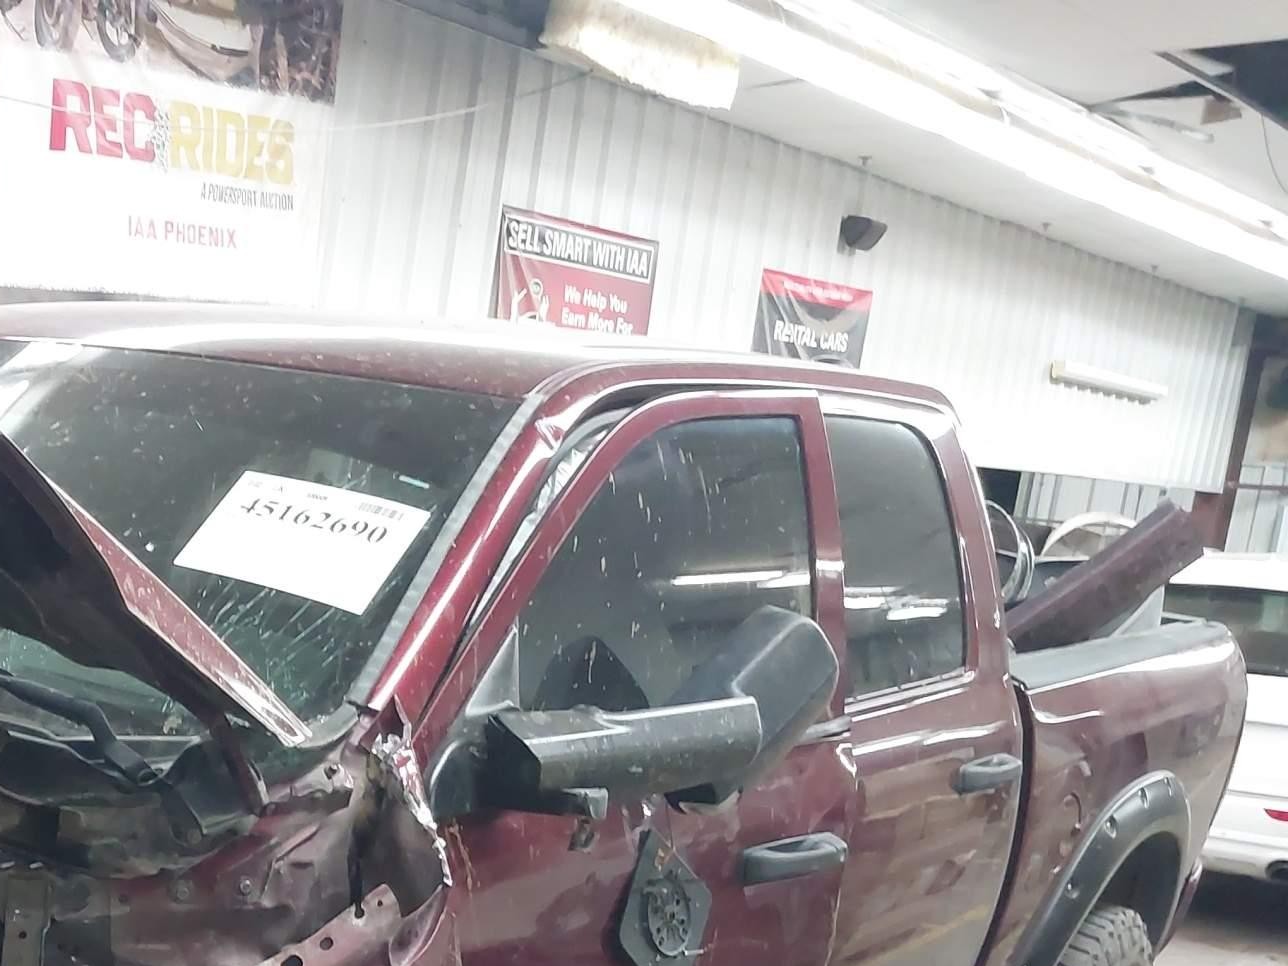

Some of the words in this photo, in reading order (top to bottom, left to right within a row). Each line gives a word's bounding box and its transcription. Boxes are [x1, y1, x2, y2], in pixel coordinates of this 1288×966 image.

[49, 78, 157, 163] REC
[168, 100, 295, 185] RIDES
[207, 183, 257, 209] POWERSPORT
[259, 191, 294, 211] AUCTION
[128, 215, 157, 241] IAA
[164, 219, 238, 249] PHOENIX
[508, 220, 542, 254] SELL
[543, 230, 592, 263] SMART
[592, 241, 626, 271] WITH
[626, 249, 649, 277] IAA
[564, 284, 581, 304] We
[583, 288, 607, 312] Help
[609, 293, 628, 314] You
[561, 306, 586, 328] Earn
[588, 310, 615, 334] More
[773, 320, 817, 348] RENTAL
[820, 331, 848, 353] CARS
[240, 498, 387, 543] 45162690
